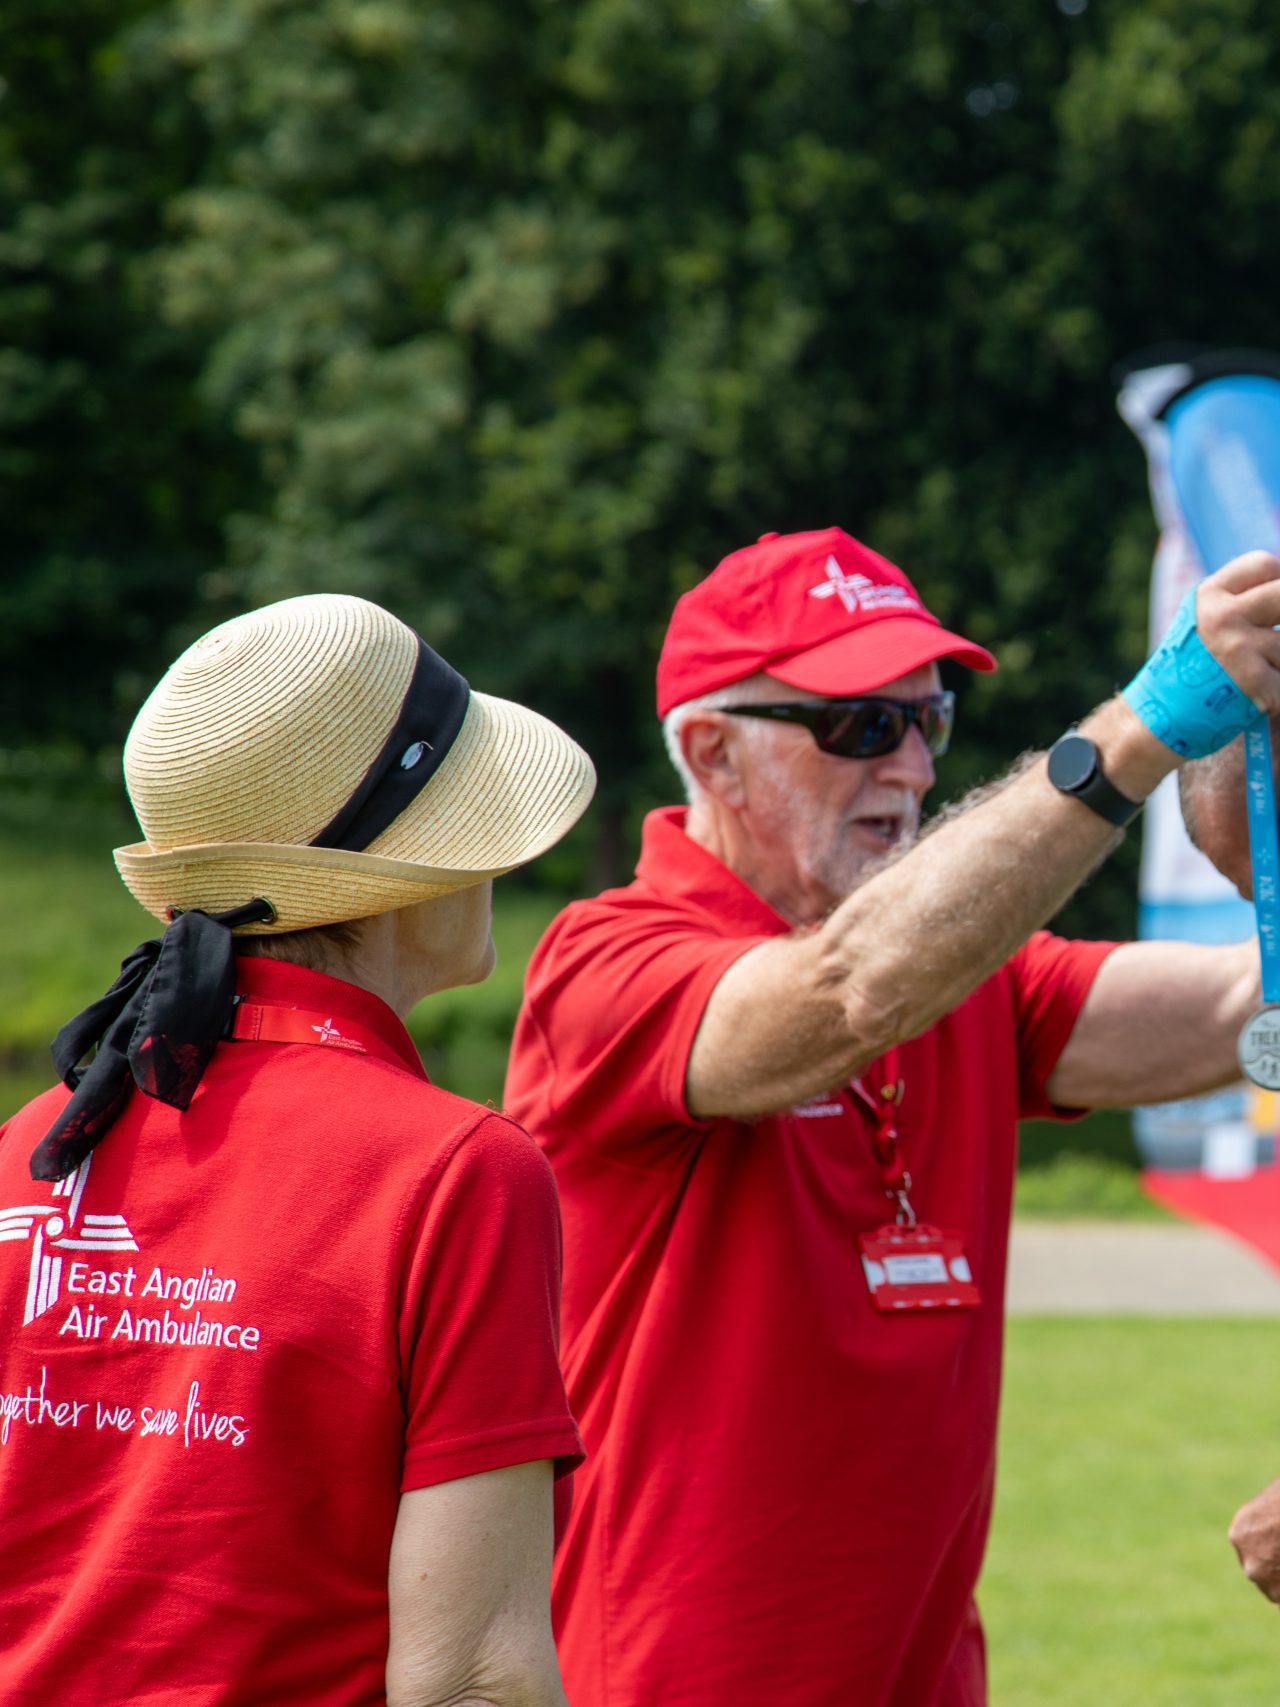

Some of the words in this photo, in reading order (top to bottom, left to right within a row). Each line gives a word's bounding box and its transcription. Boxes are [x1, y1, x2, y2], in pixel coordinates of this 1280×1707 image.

[67, 1262, 137, 1297] East
[141, 1267, 237, 1310] Anglian
[59, 1304, 109, 1338] Air
[111, 1309, 260, 1350] Ambulance
[96, 1401, 135, 1432] we
[140, 1406, 179, 1437] save
[183, 1380, 250, 1448] lives
